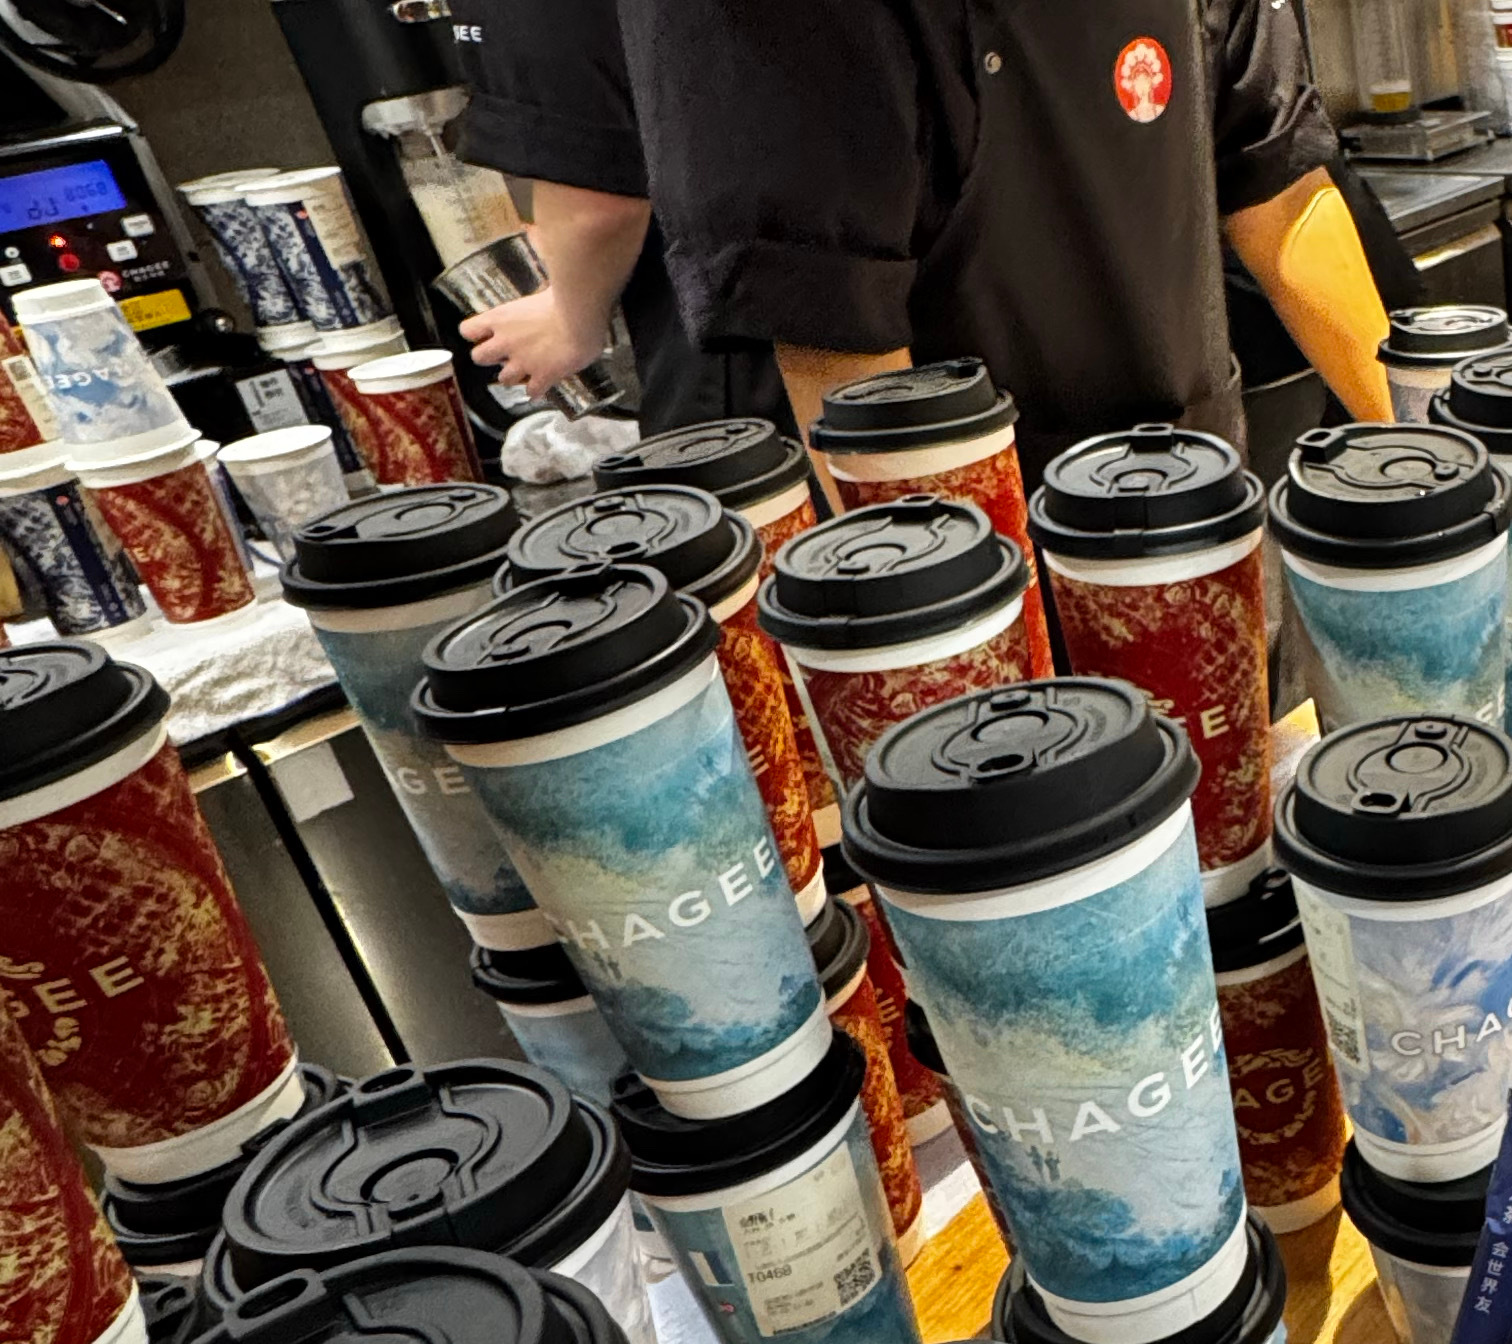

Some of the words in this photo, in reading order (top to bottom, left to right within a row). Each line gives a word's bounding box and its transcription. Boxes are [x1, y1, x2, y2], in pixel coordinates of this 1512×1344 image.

[964, 999, 1223, 1144] CHAGEE
[1473, 1240, 1511, 1316] 会世界友
